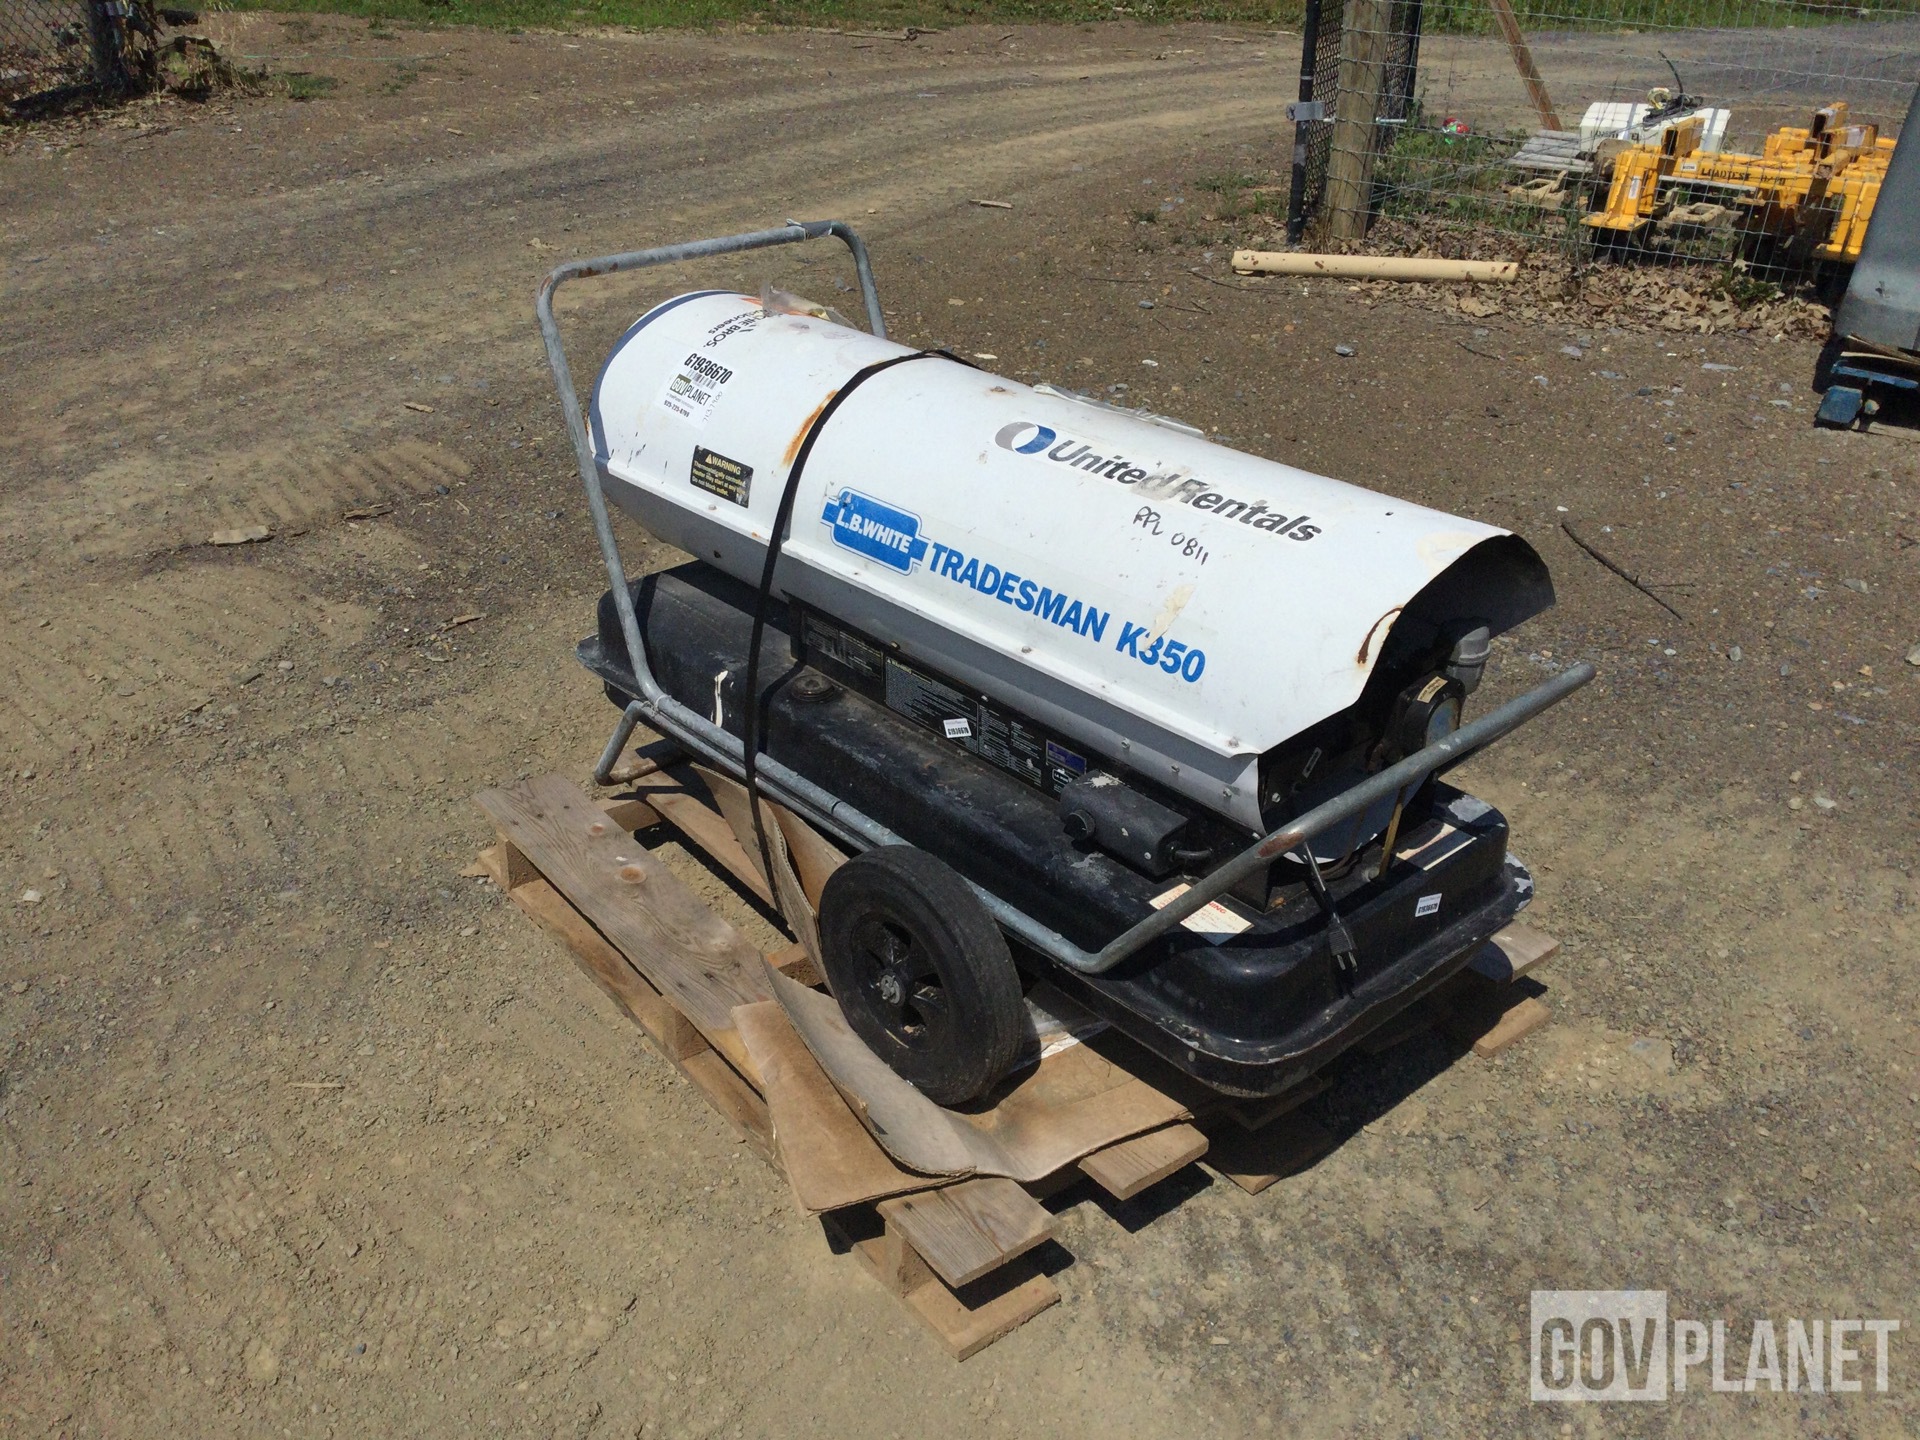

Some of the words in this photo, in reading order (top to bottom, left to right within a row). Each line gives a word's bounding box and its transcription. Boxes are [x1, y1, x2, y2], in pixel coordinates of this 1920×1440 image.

[684, 352, 733, 384] G1936670
[712, 456, 741, 475] WARNING
[1171, 532, 1209, 565] 0811
[929, 542, 1111, 643] TRADESMAN
[1116, 622, 1206, 683] K350
